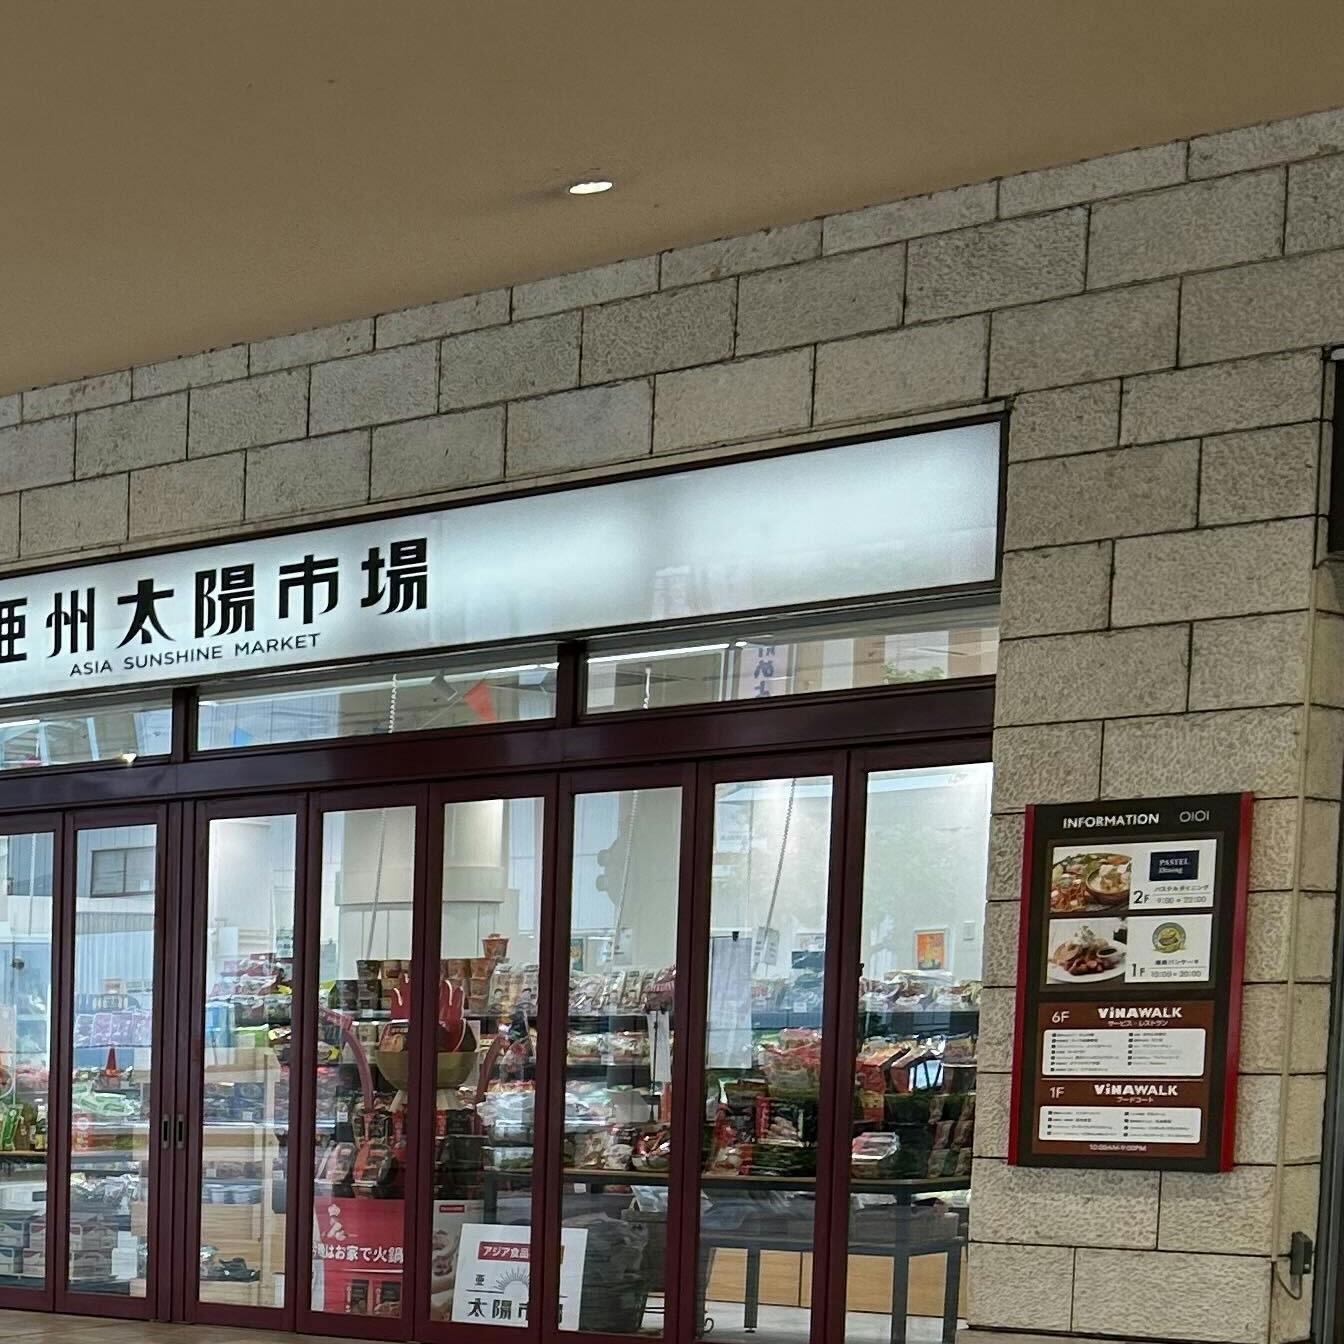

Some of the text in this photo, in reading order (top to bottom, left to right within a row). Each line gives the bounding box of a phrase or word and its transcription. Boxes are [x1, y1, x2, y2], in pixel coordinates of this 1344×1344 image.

[69, 632, 321, 677] ASIA SUNSHINE MARKET
[1063, 812, 1160, 829] INFORMATION
[1159, 858, 1189, 866] PASTEL
[1133, 890, 1149, 904] 2F
[1132, 963, 1145, 977] 1F
[1051, 1011, 1070, 1023] 6F
[1049, 1086, 1065, 1098] 1F
